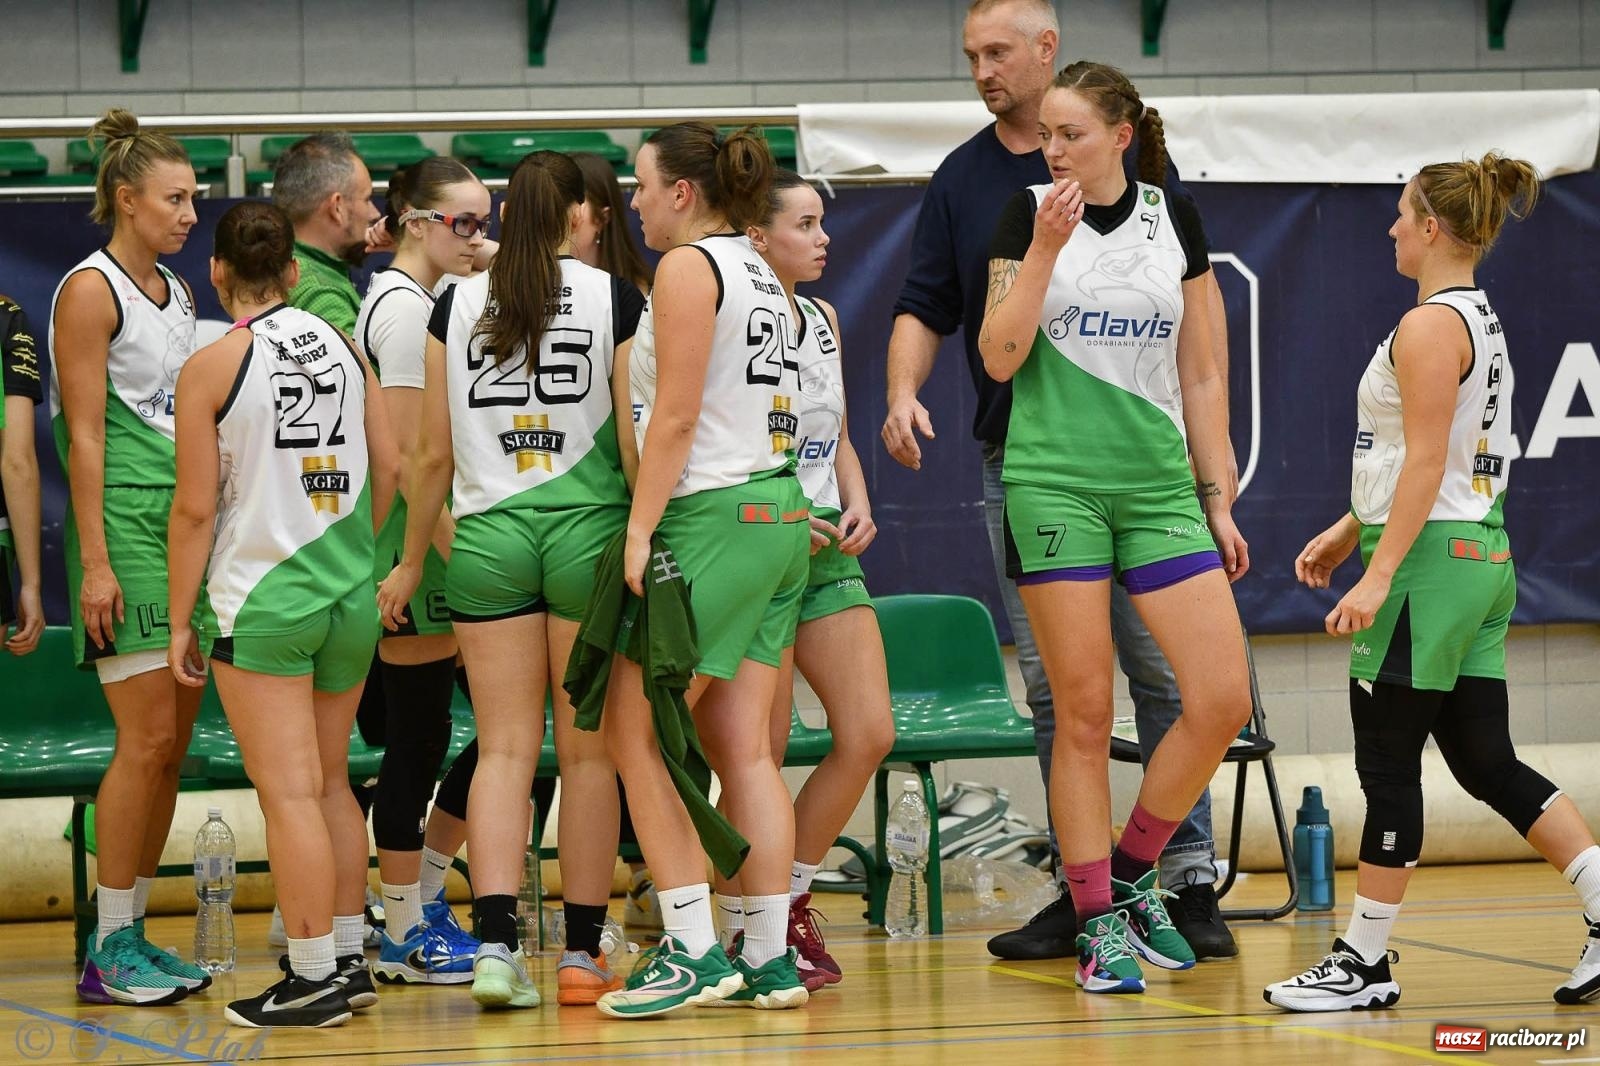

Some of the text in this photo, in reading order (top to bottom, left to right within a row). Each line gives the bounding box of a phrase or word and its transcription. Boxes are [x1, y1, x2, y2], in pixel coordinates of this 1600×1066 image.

[1141, 212, 1160, 241] 7
[1079, 311, 1174, 338] Clavis
[291, 331, 318, 349] AZS
[746, 307, 801, 392] 24
[270, 363, 346, 449] 27
[768, 414, 797, 433] SEGET
[504, 432, 561, 450] SEGET
[1475, 456, 1500, 473] GET
[304, 473, 348, 491] EGET
[1036, 523, 1067, 558] 7
[136, 602, 171, 638] 14
